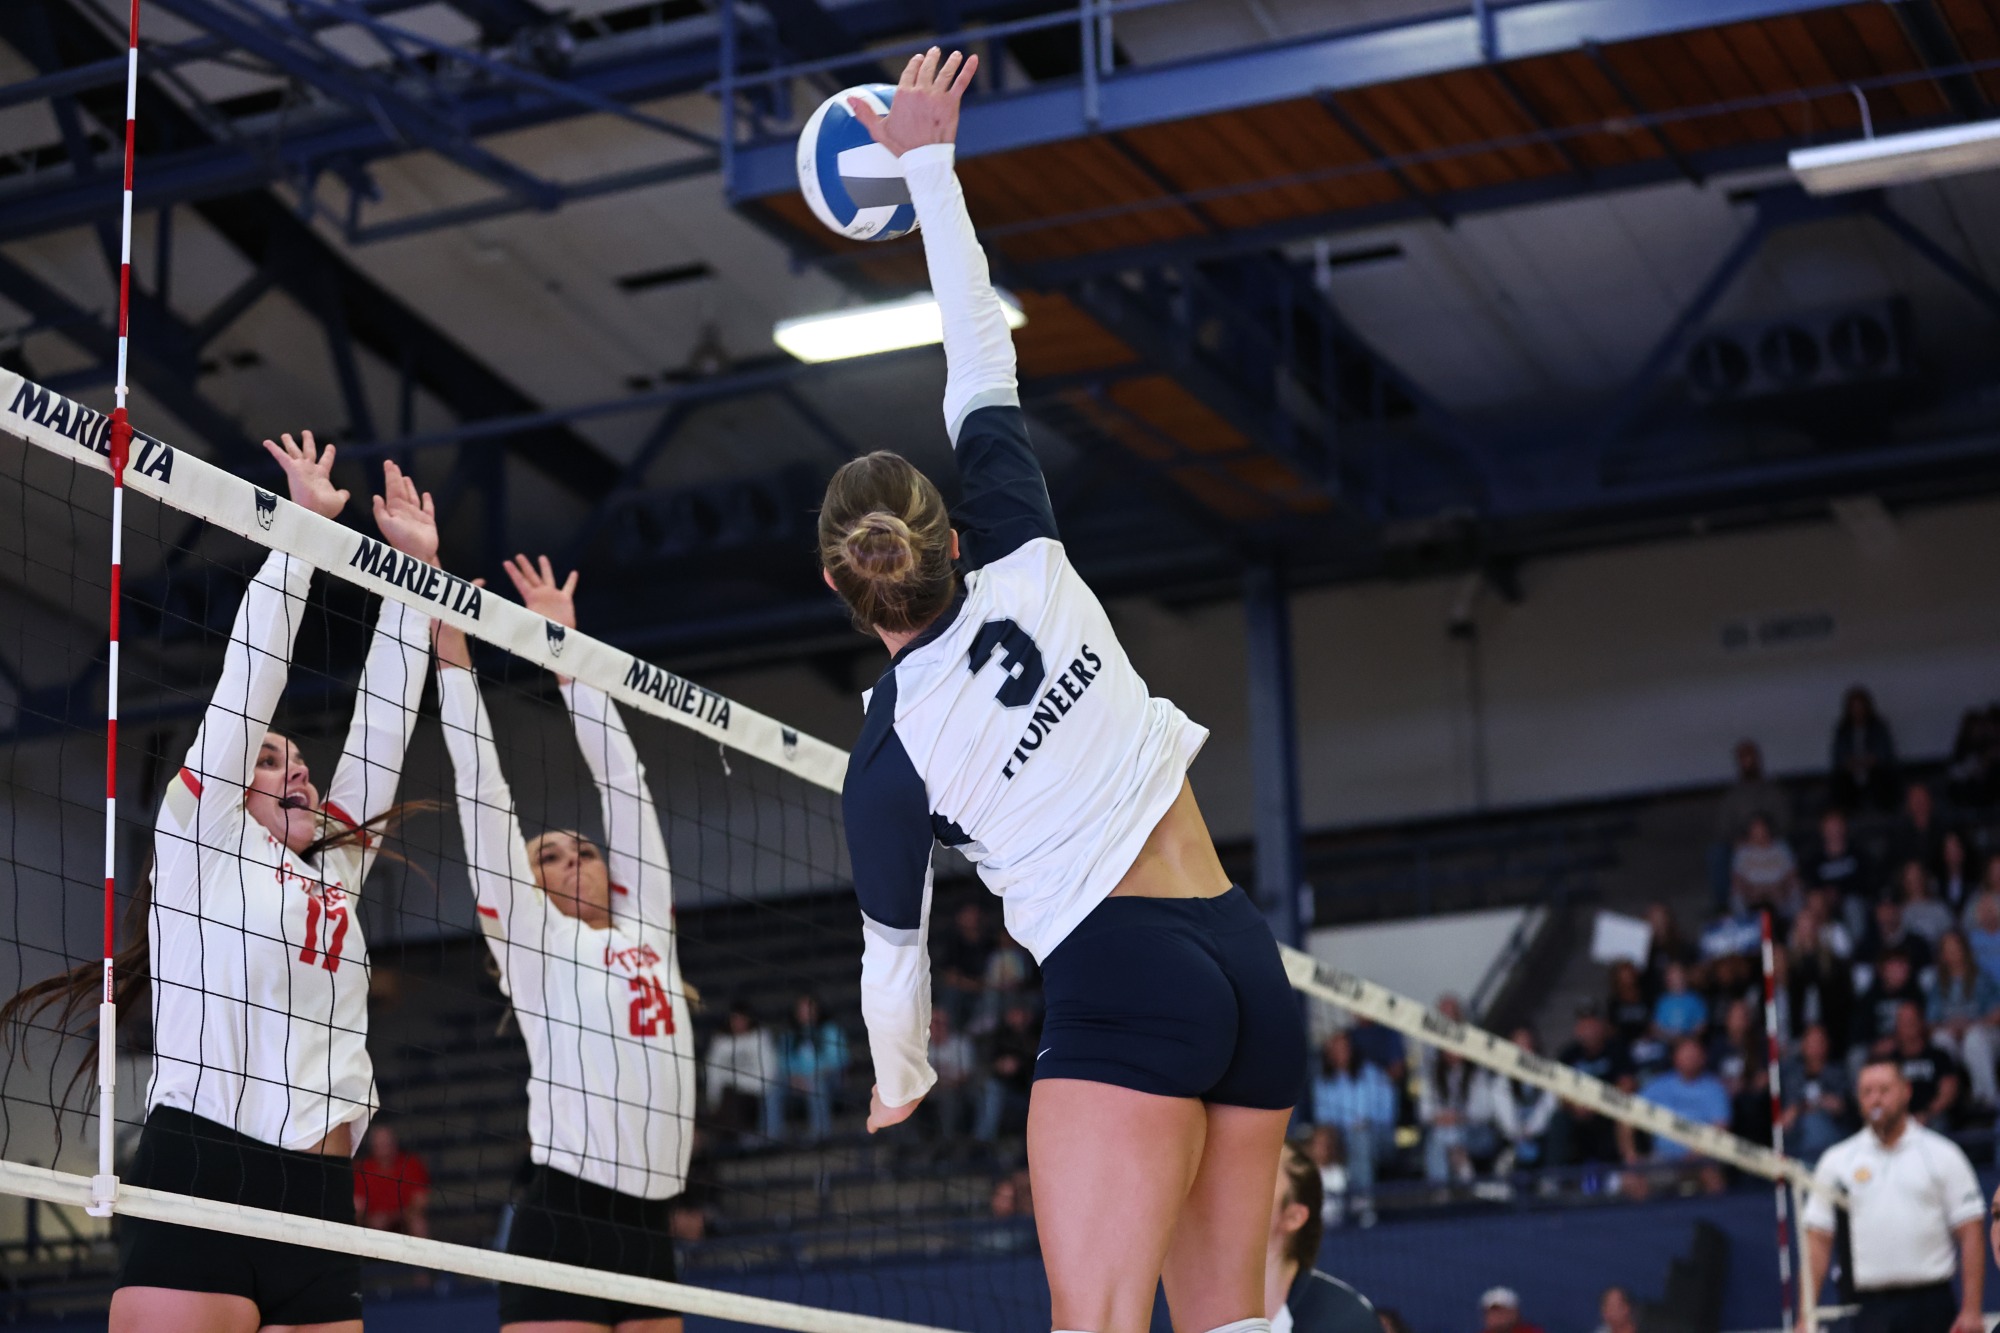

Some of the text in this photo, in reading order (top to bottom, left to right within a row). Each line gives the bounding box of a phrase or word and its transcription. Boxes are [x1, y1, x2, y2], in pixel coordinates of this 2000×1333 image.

[8, 379, 174, 484] MARIETA
[349, 535, 481, 620] MARIETTA
[623, 658, 732, 731] MARIETTA
[968, 617, 1048, 710] 3
[299, 897, 349, 973] 17
